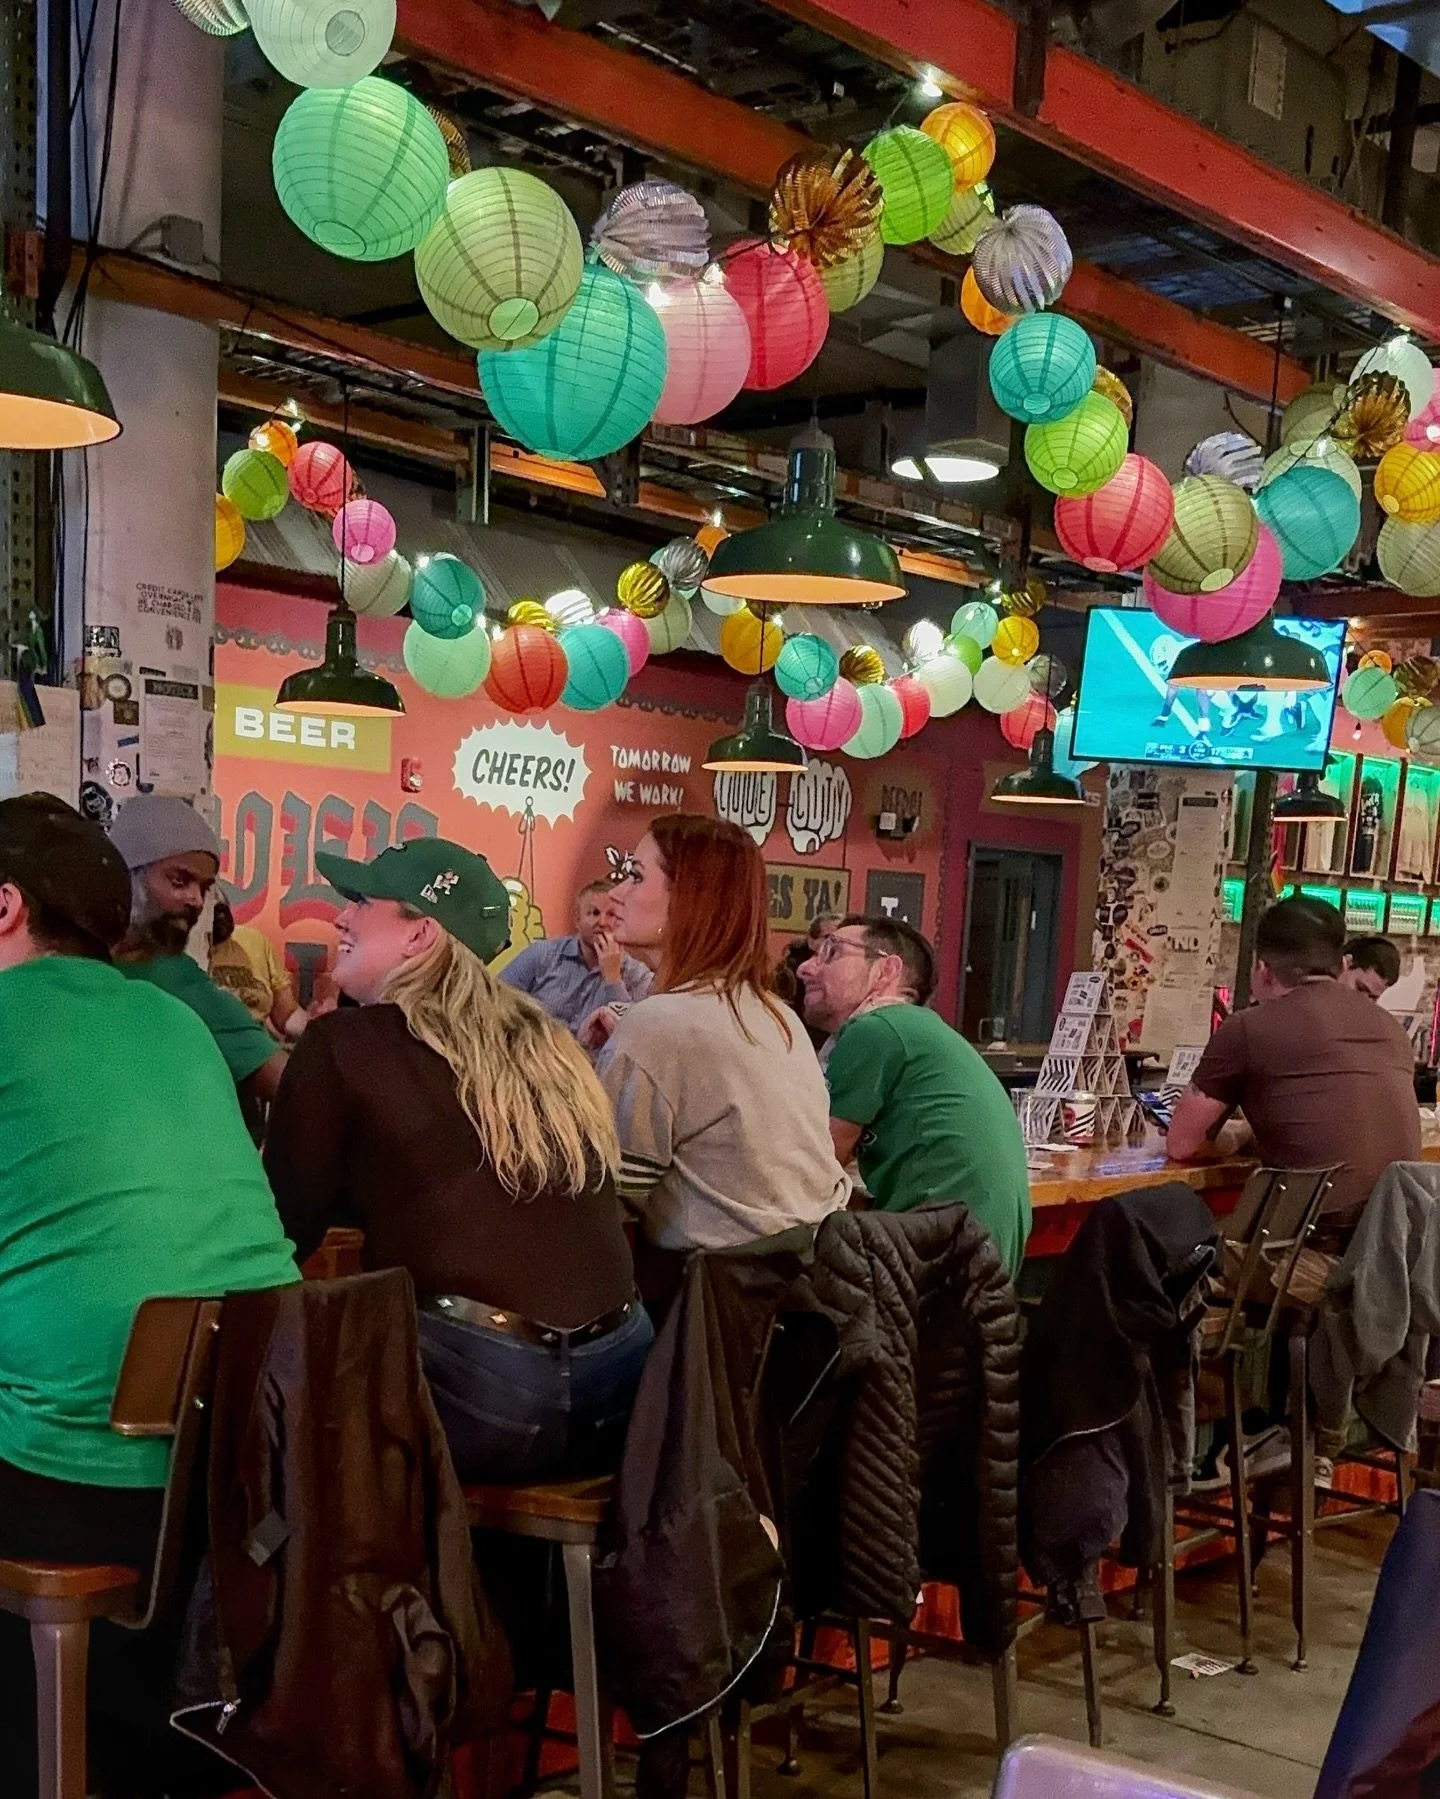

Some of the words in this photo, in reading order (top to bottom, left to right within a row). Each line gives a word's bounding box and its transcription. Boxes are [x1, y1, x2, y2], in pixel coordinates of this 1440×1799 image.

[234, 706, 355, 750] BEER
[472, 748, 575, 792] CHEERS!
[610, 745, 692, 774] TOMORROW
[614, 779, 636, 803] WE
[639, 783, 684, 813] WORK!
[803, 877, 842, 921] YA!
